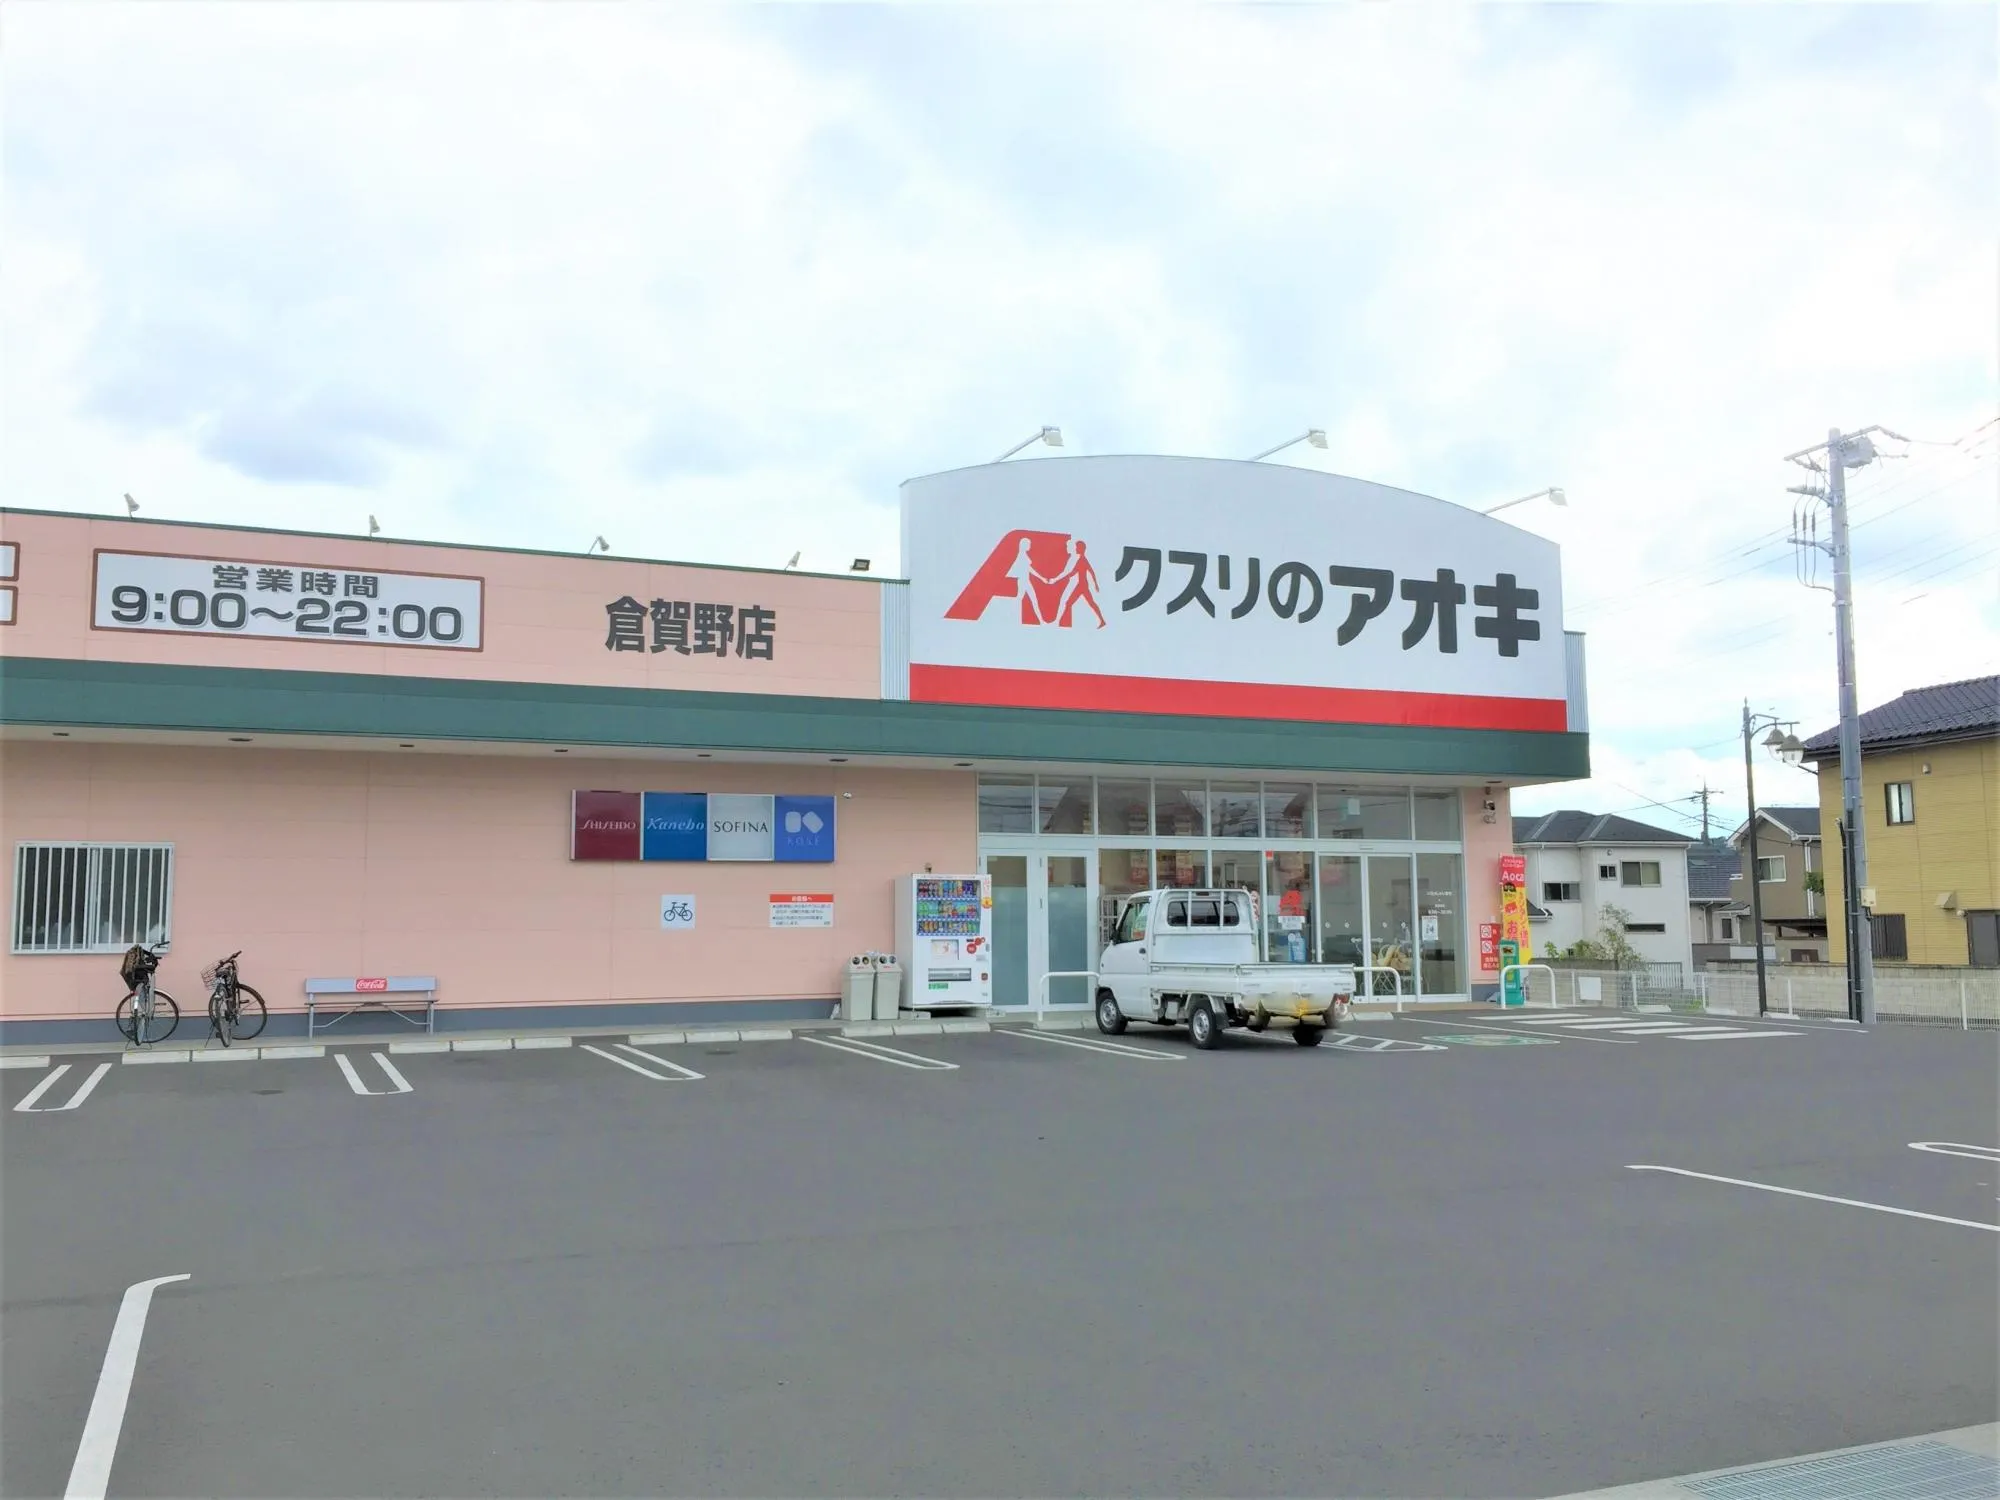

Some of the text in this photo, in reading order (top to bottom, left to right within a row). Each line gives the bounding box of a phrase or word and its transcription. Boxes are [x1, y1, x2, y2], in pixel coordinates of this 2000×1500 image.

[212, 565, 379, 599] 営業時間
[1115, 546, 1540, 657] クスリのアオキ
[605, 596, 776, 661] 倉賀野店
[579, 819, 636, 830] SHISEIDO
[646, 817, 705, 832] Kanebo
[713, 820, 768, 833] SOFINA
